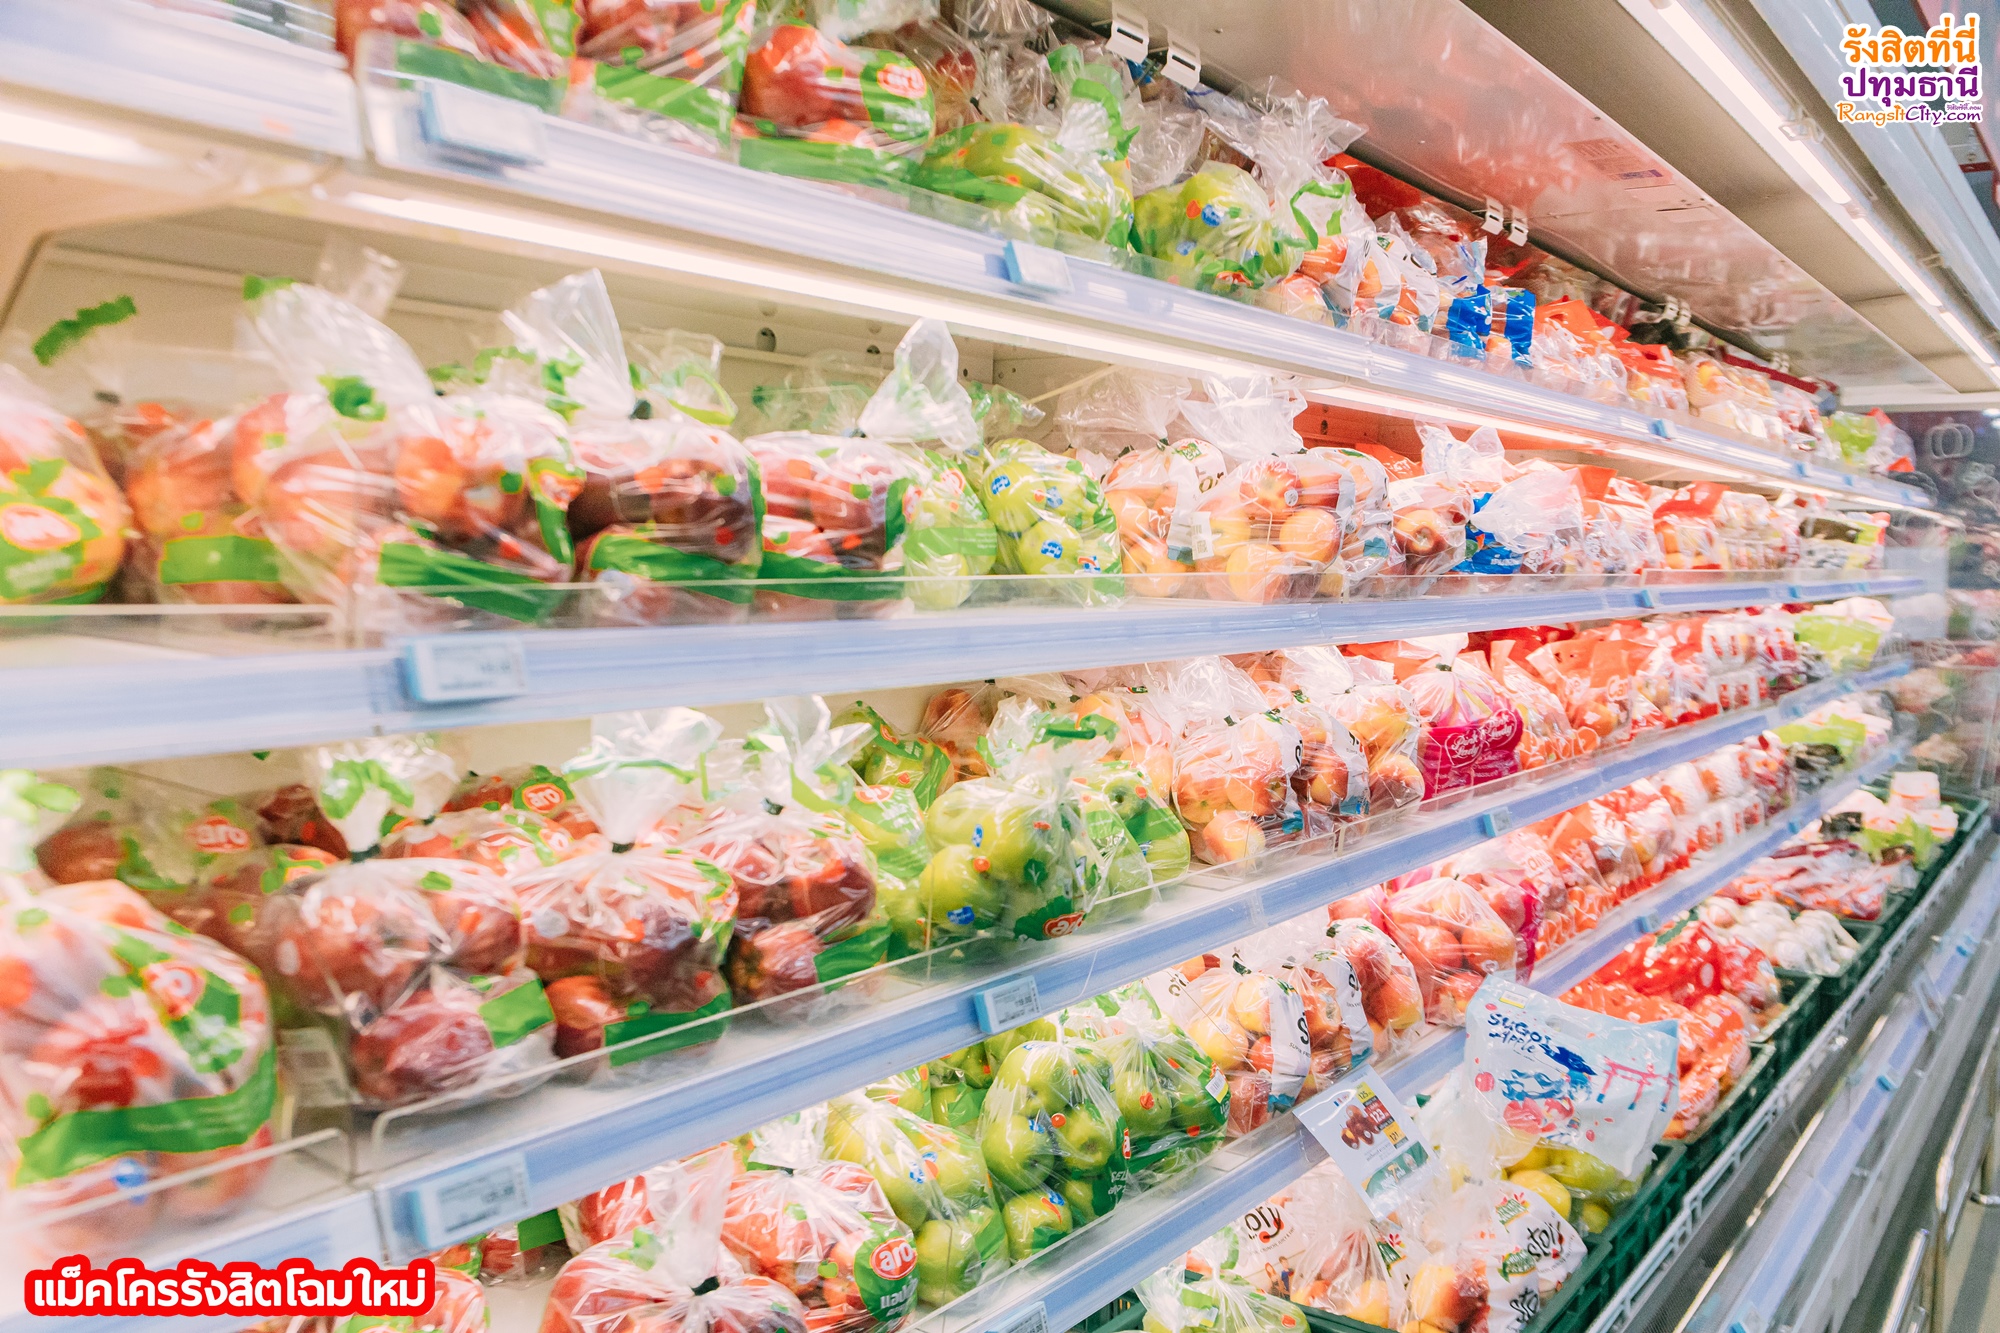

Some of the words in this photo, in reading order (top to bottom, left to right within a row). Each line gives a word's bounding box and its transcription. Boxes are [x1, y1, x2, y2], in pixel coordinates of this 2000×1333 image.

[1451, 727, 1479, 750] Pink
[1456, 745, 1481, 759] Lady
[528, 788, 561, 808] aro
[196, 824, 249, 845] aro
[879, 1241, 914, 1272] aro
